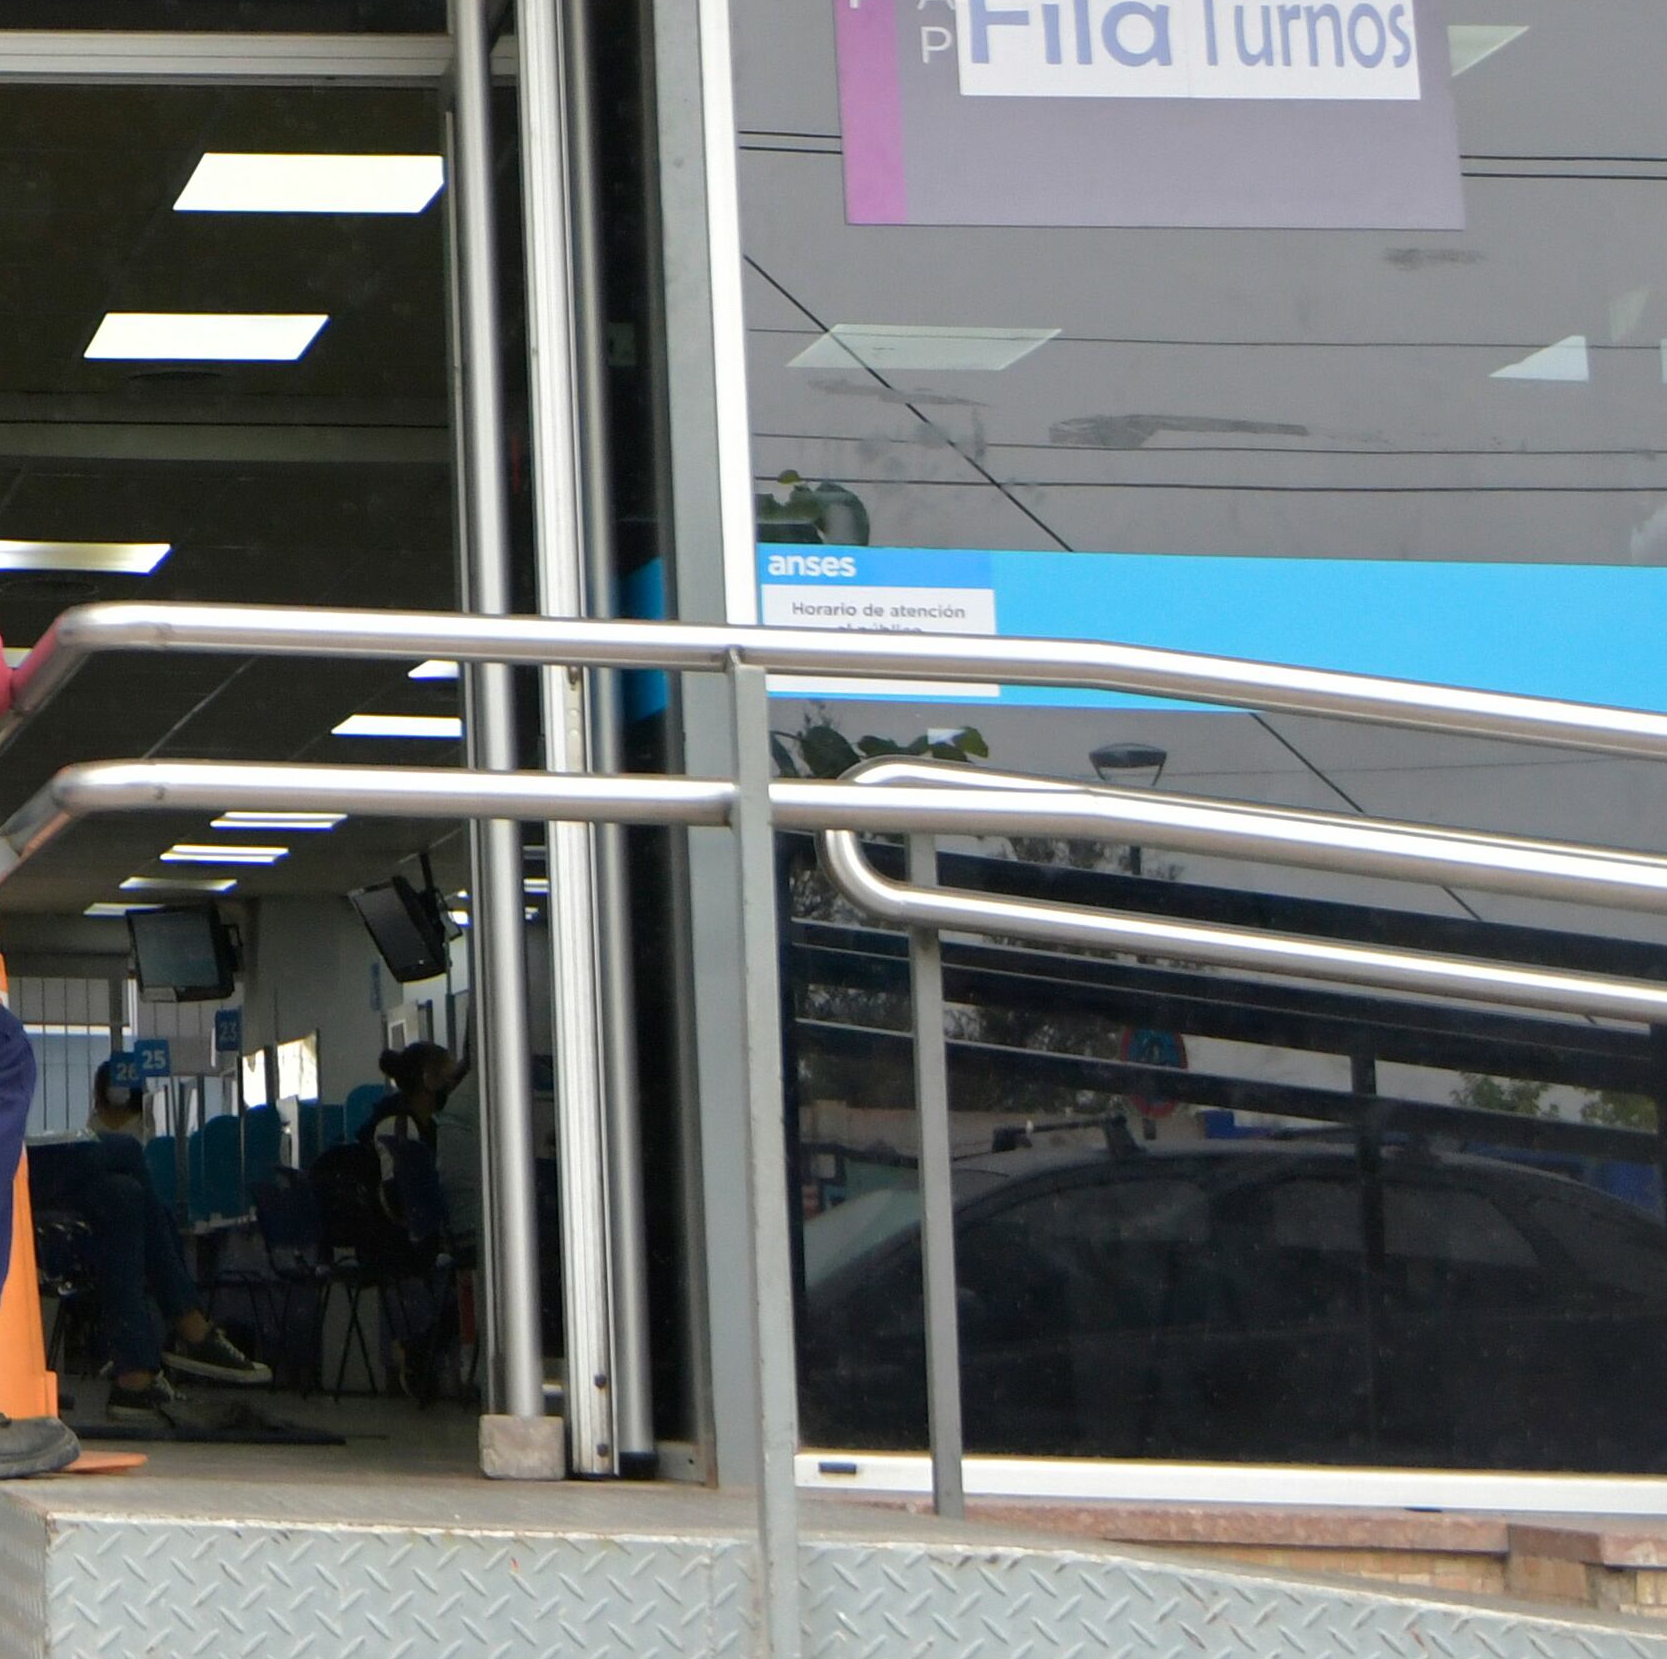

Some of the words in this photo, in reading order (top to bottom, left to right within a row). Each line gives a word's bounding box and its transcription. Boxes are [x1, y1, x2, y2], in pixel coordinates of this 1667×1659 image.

[768, 554, 857, 578] anses
[791, 601, 857, 618] Horario
[862, 602, 884, 618] de
[889, 602, 966, 620] atención
[141, 1049, 167, 1069] 25
